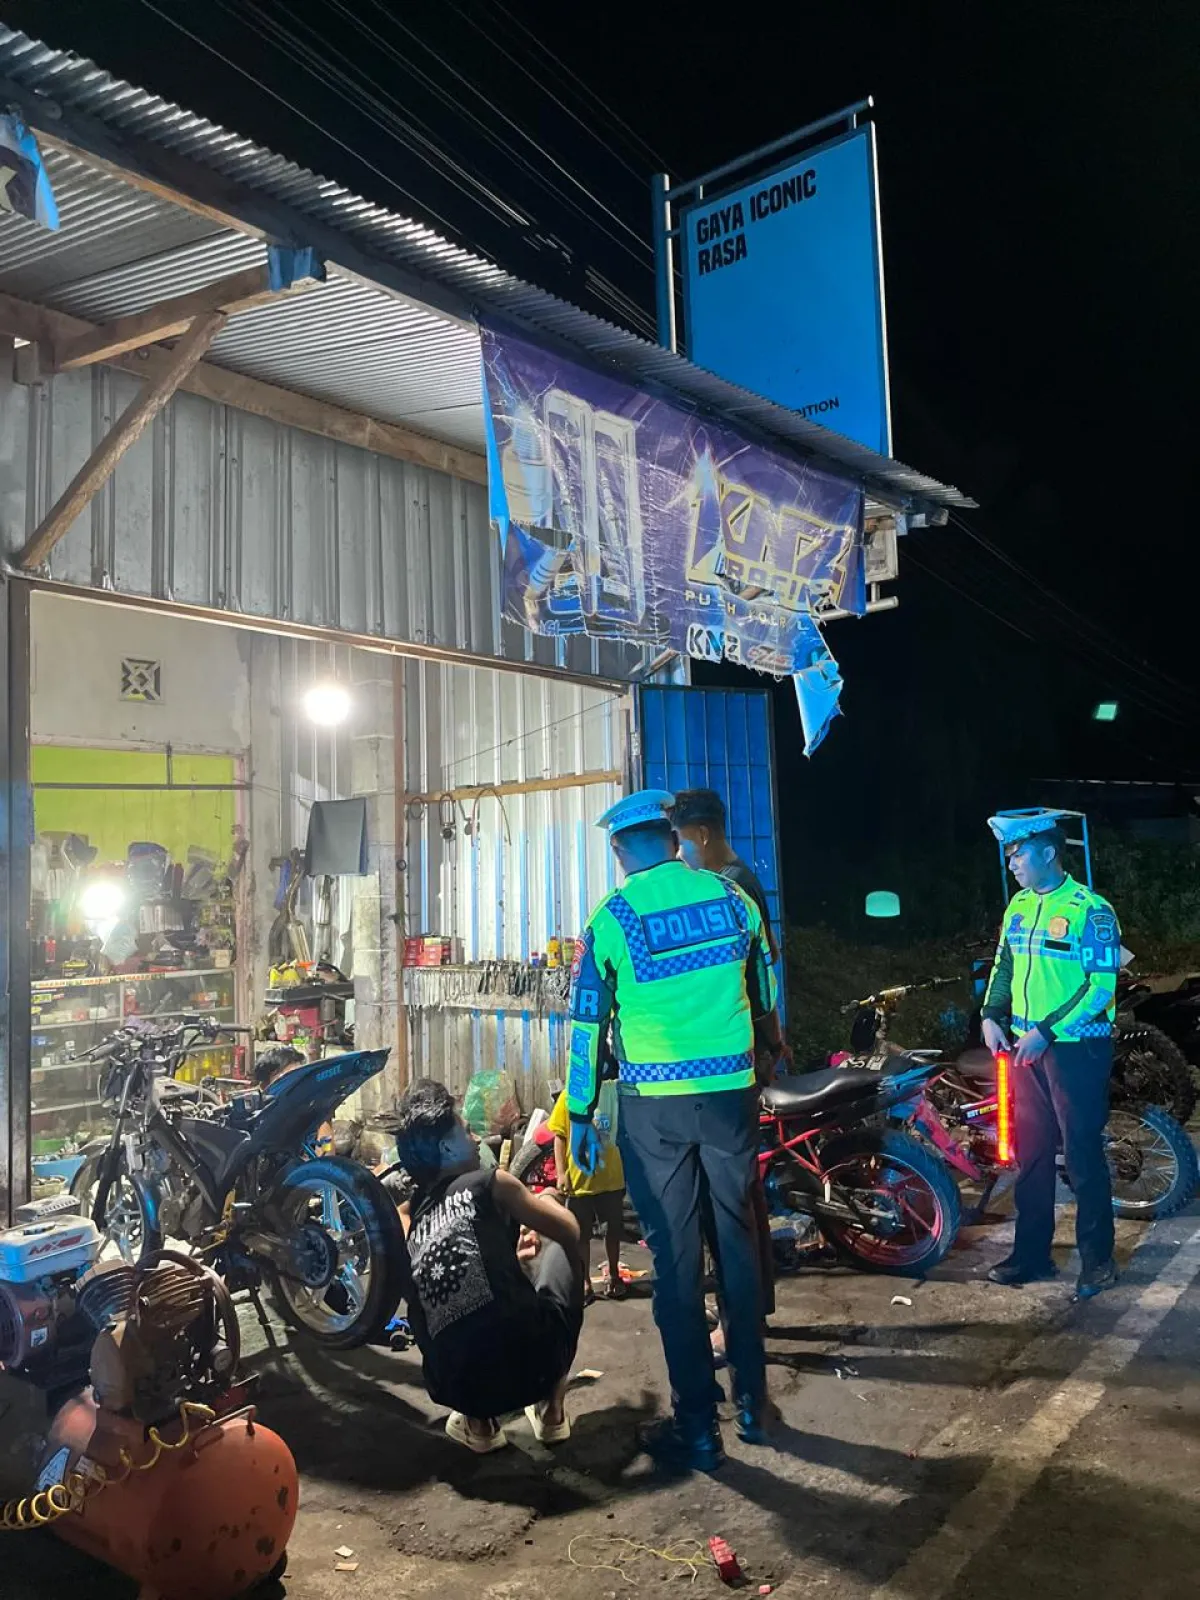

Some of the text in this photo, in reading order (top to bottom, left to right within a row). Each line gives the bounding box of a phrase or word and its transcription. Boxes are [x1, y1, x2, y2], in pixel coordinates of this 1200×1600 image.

[696, 169, 817, 246] GAYA ICONIC
[698, 232, 747, 276] RASA
[685, 589, 736, 615] PUH
[648, 904, 735, 945] POLISI
[1082, 946, 1118, 968] PJ
